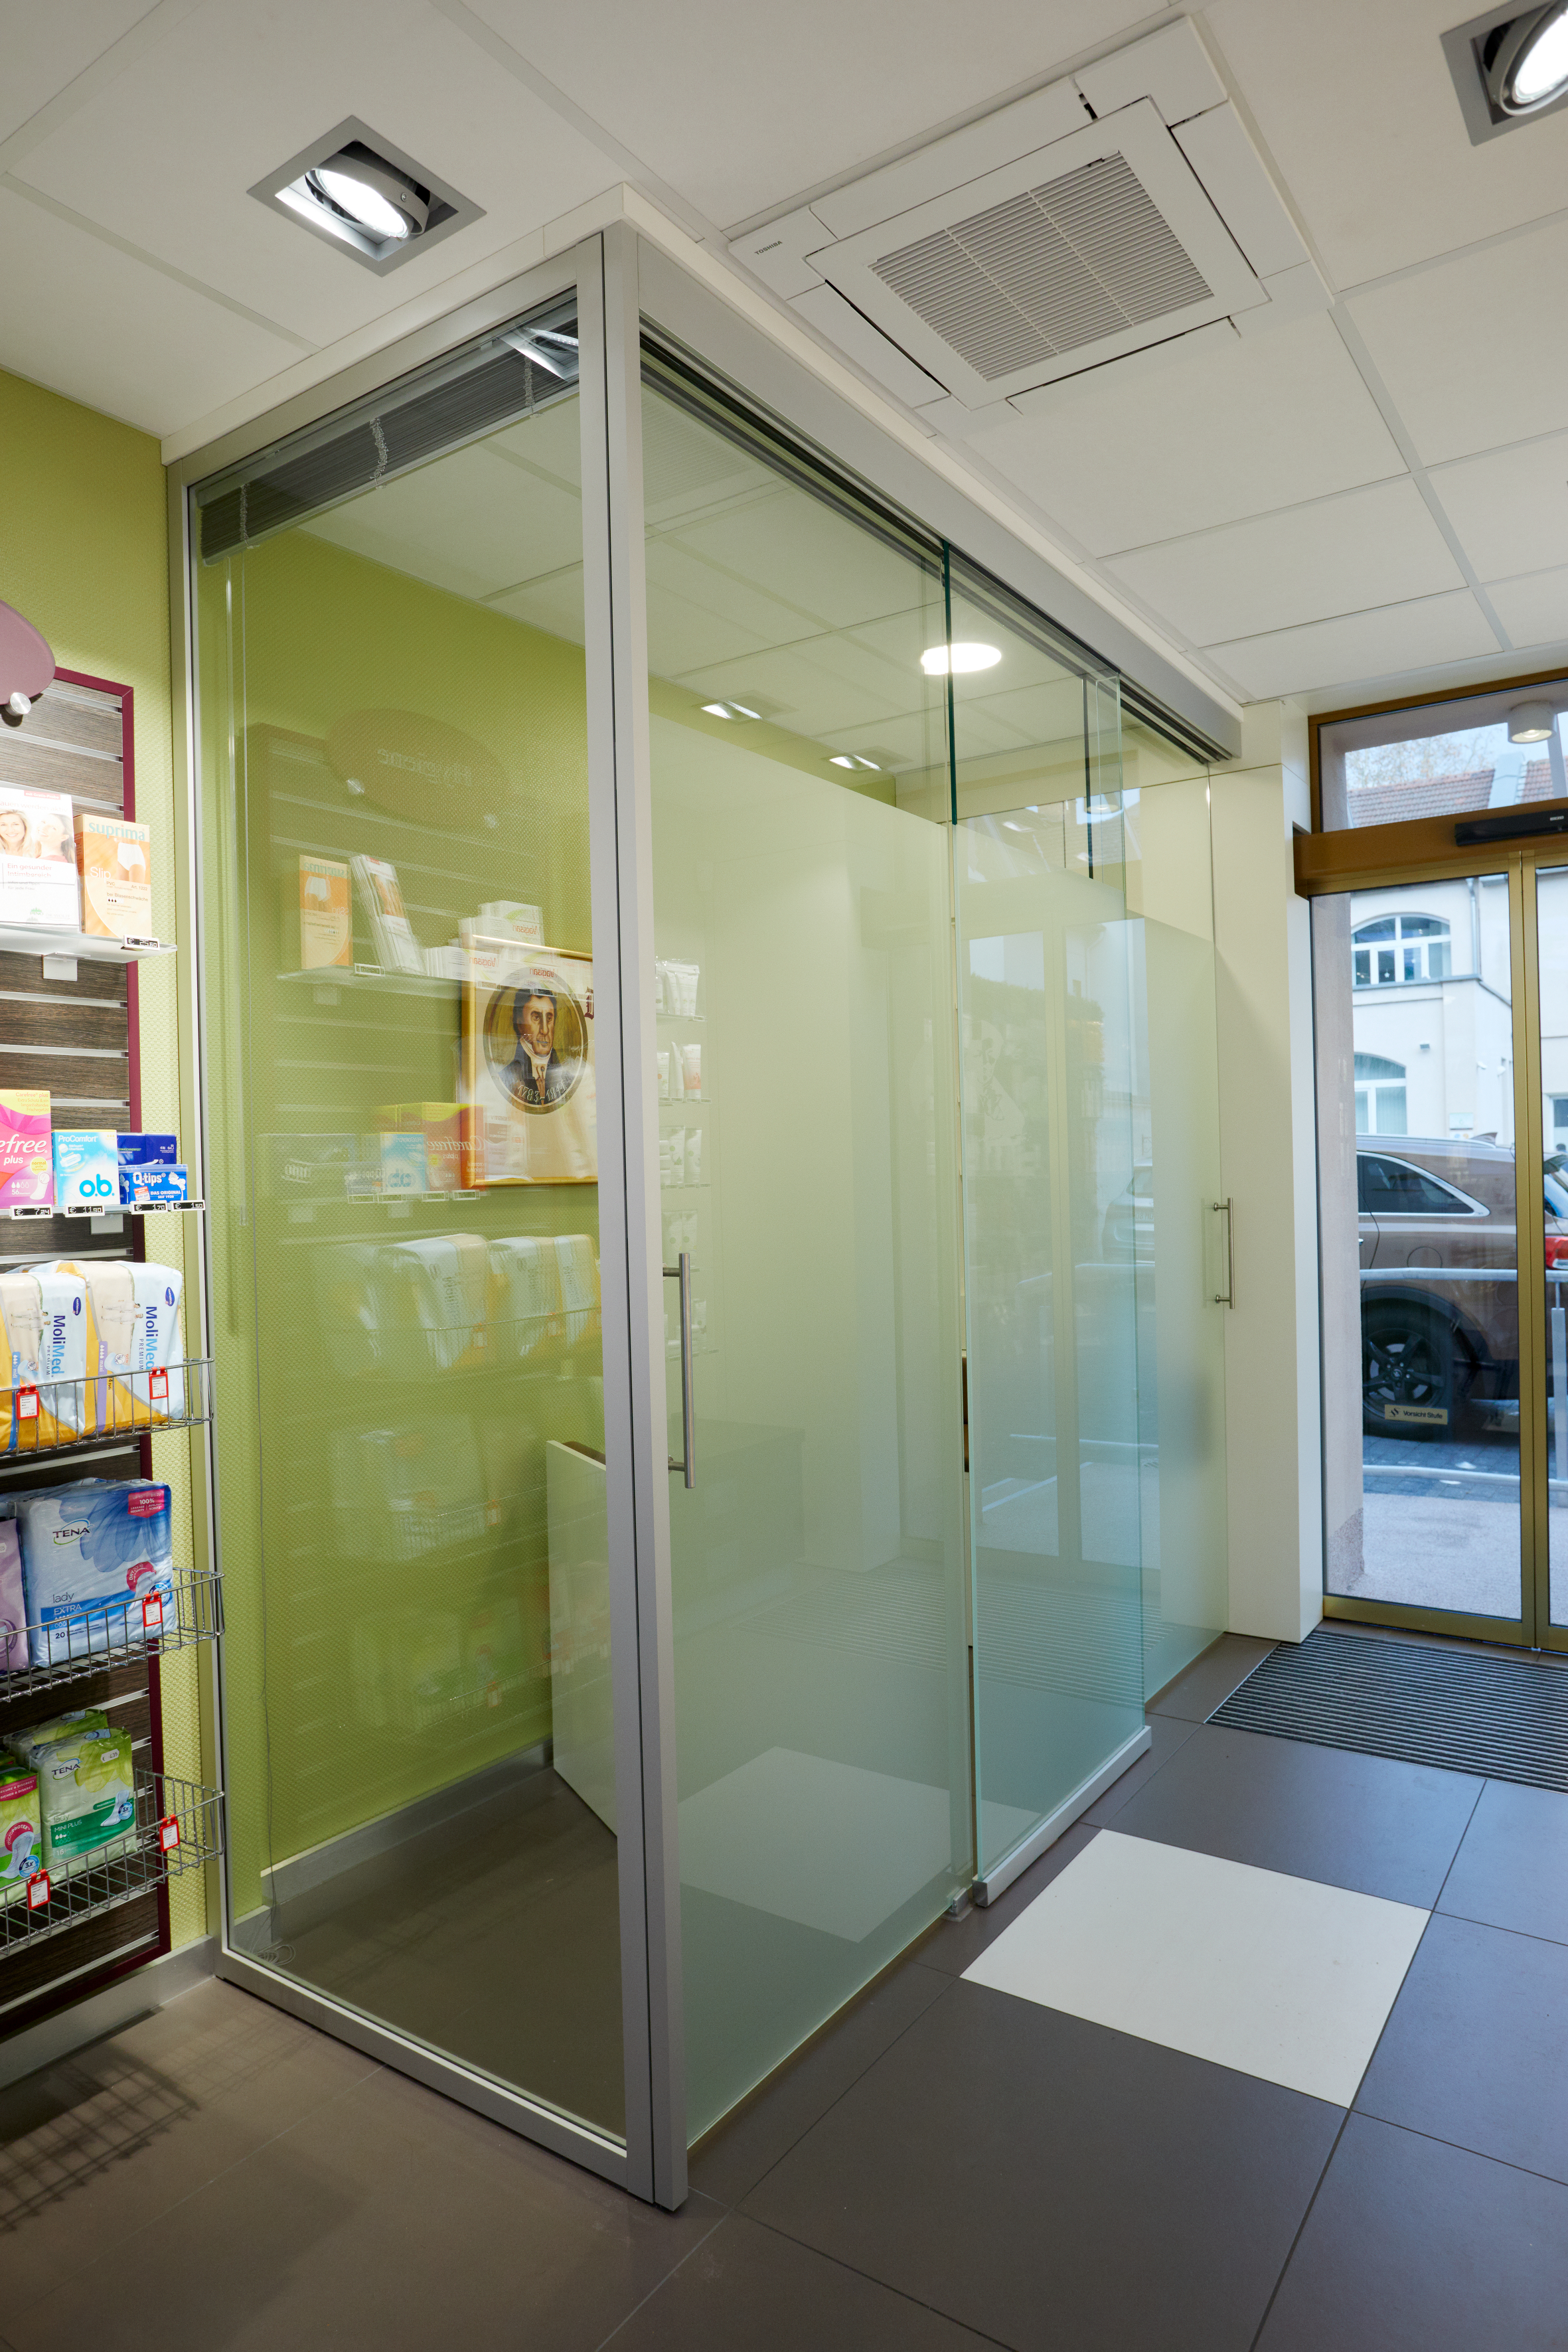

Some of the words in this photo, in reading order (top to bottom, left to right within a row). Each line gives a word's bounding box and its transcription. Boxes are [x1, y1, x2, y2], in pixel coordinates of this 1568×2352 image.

[754, 240, 783, 255] TOSHIBA
[88, 823, 145, 841] suprima
[90, 866, 111, 883] Slip
[3, 1155, 24, 1166] plus
[79, 1174, 115, 1198] o.b.
[51, 1315, 66, 1375] MoliMed
[52, 1527, 90, 1538] TENA
[52, 1592, 74, 1603] lady
[54, 1604, 82, 1615] EXTRA
[51, 1763, 80, 1775] TENA
[17, 1780, 35, 1788] DISCREET
[18, 1785, 33, 1794] DISKRET
[53, 1814, 70, 1824] lady
[68, 1819, 82, 1829] PLUS
